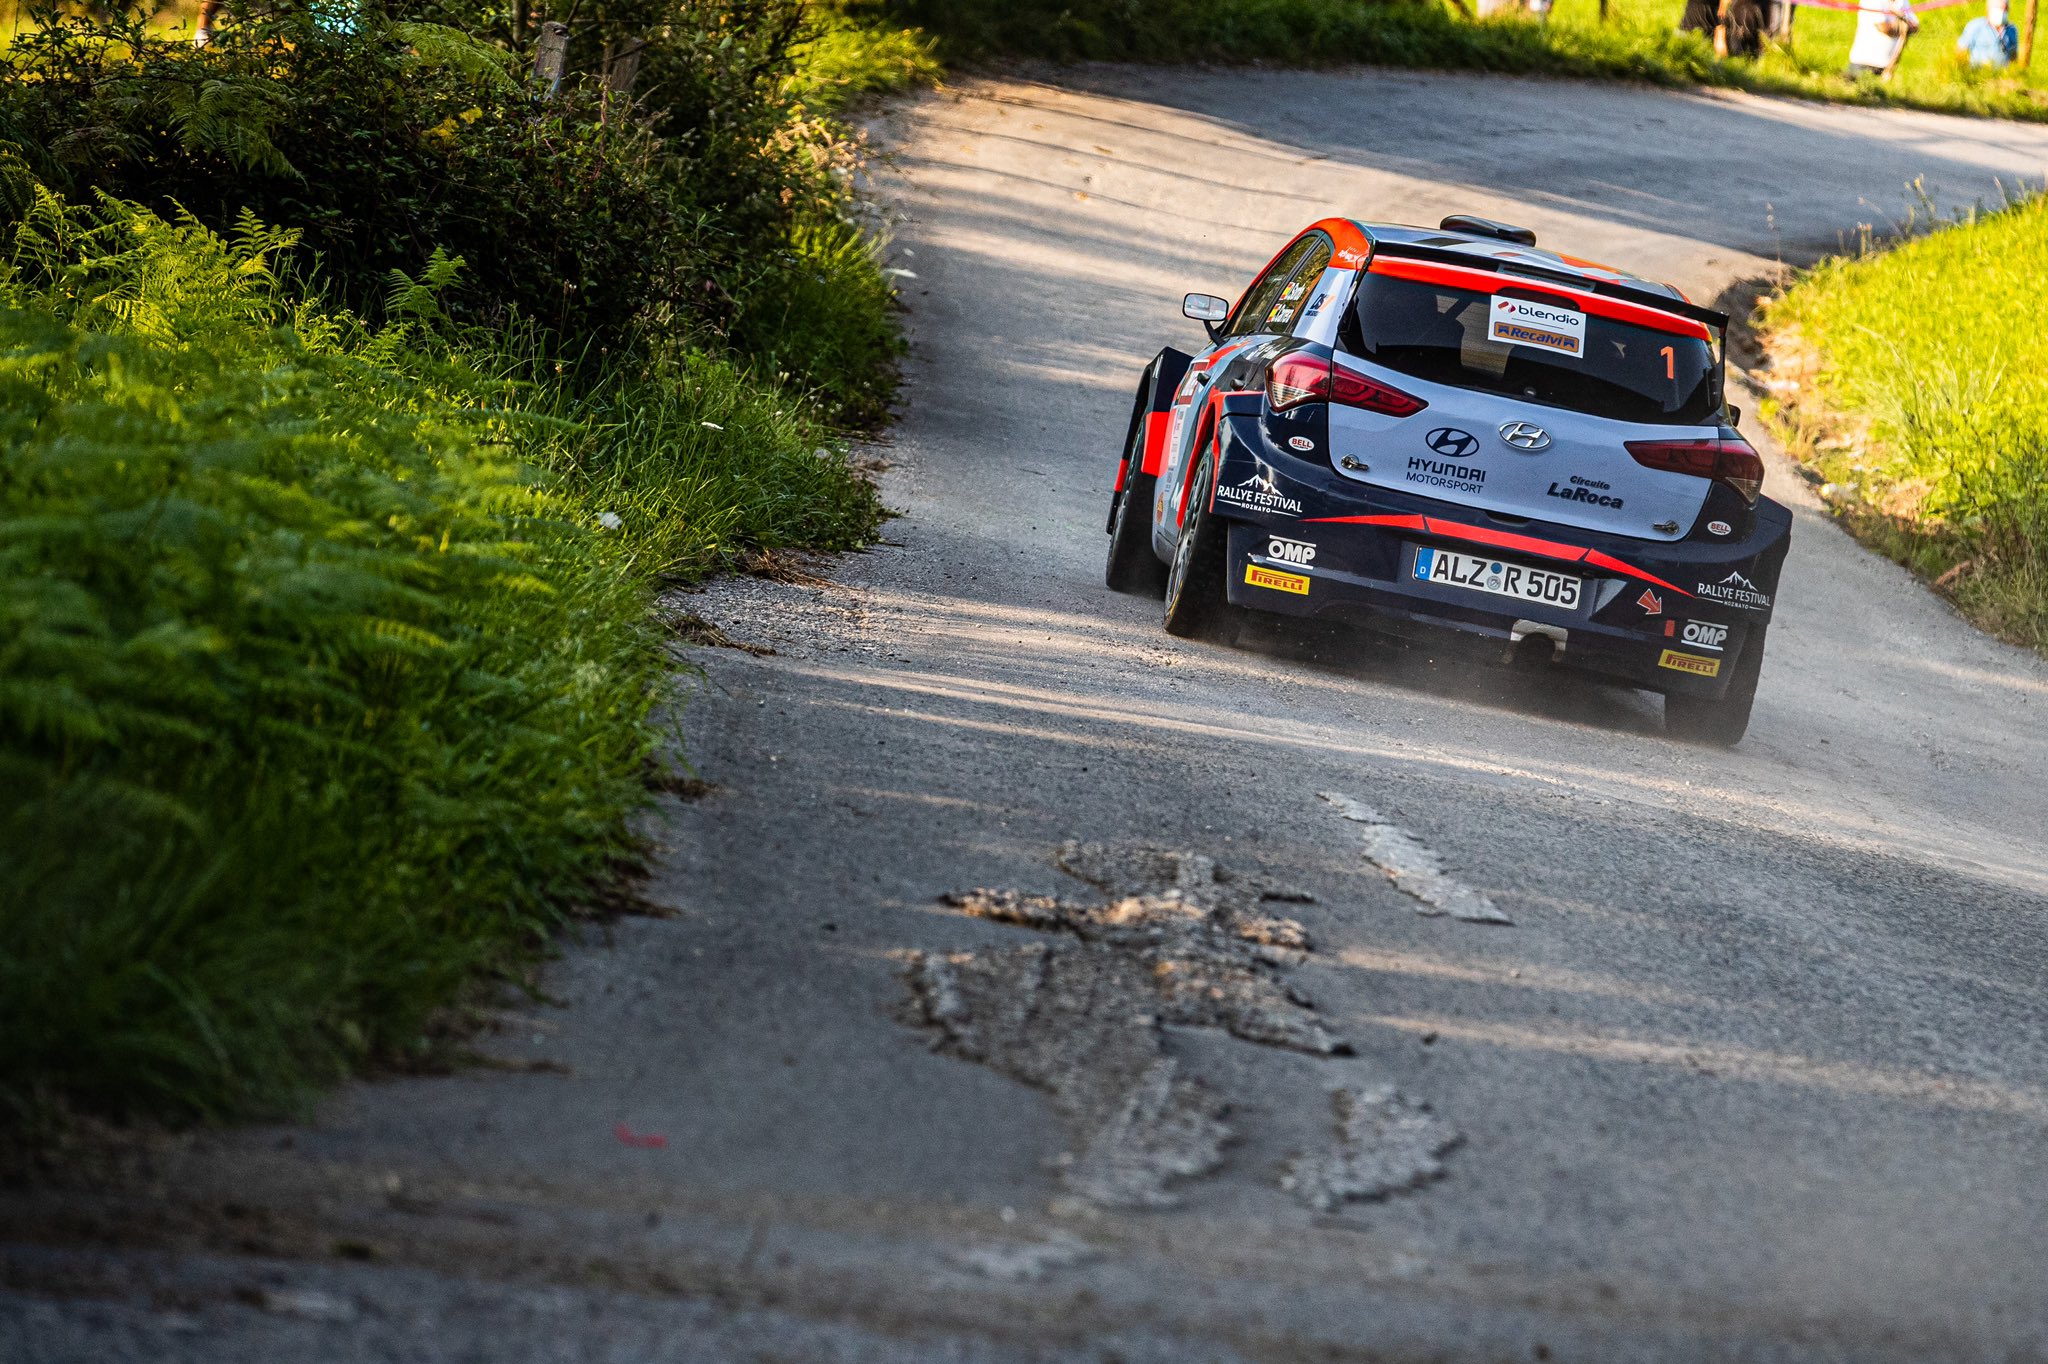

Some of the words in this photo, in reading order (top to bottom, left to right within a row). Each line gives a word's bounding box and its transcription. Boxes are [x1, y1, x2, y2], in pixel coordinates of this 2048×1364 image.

[1518, 304, 1580, 327] blendio
[1510, 326, 1564, 347] Recalvi
[1660, 345, 1675, 380] 1
[1291, 438, 1312, 448] BELL
[1407, 456, 1487, 483] HYUNDAI
[1405, 471, 1484, 494] MOTORSPORT
[1569, 475, 1610, 490] Circuito
[1217, 485, 1253, 502] RALLYE
[1254, 492, 1303, 513] FESTIVAL
[1546, 482, 1624, 510] LaRoca
[1241, 503, 1271, 513] HOZNAYO
[1710, 522, 1730, 533] BELL
[1268, 539, 1316, 565] OMP
[1251, 569, 1304, 592] PIRELLI
[1419, 566, 1426, 575] D
[1432, 553, 1487, 588] ALZ
[1503, 566, 1522, 594] R
[1526, 572, 1579, 605] 505
[1698, 583, 1734, 600] RALLYE
[1735, 589, 1771, 607] FESTIVAL
[1683, 623, 1727, 646] OMP
[1665, 653, 1716, 674] PIRELLI
